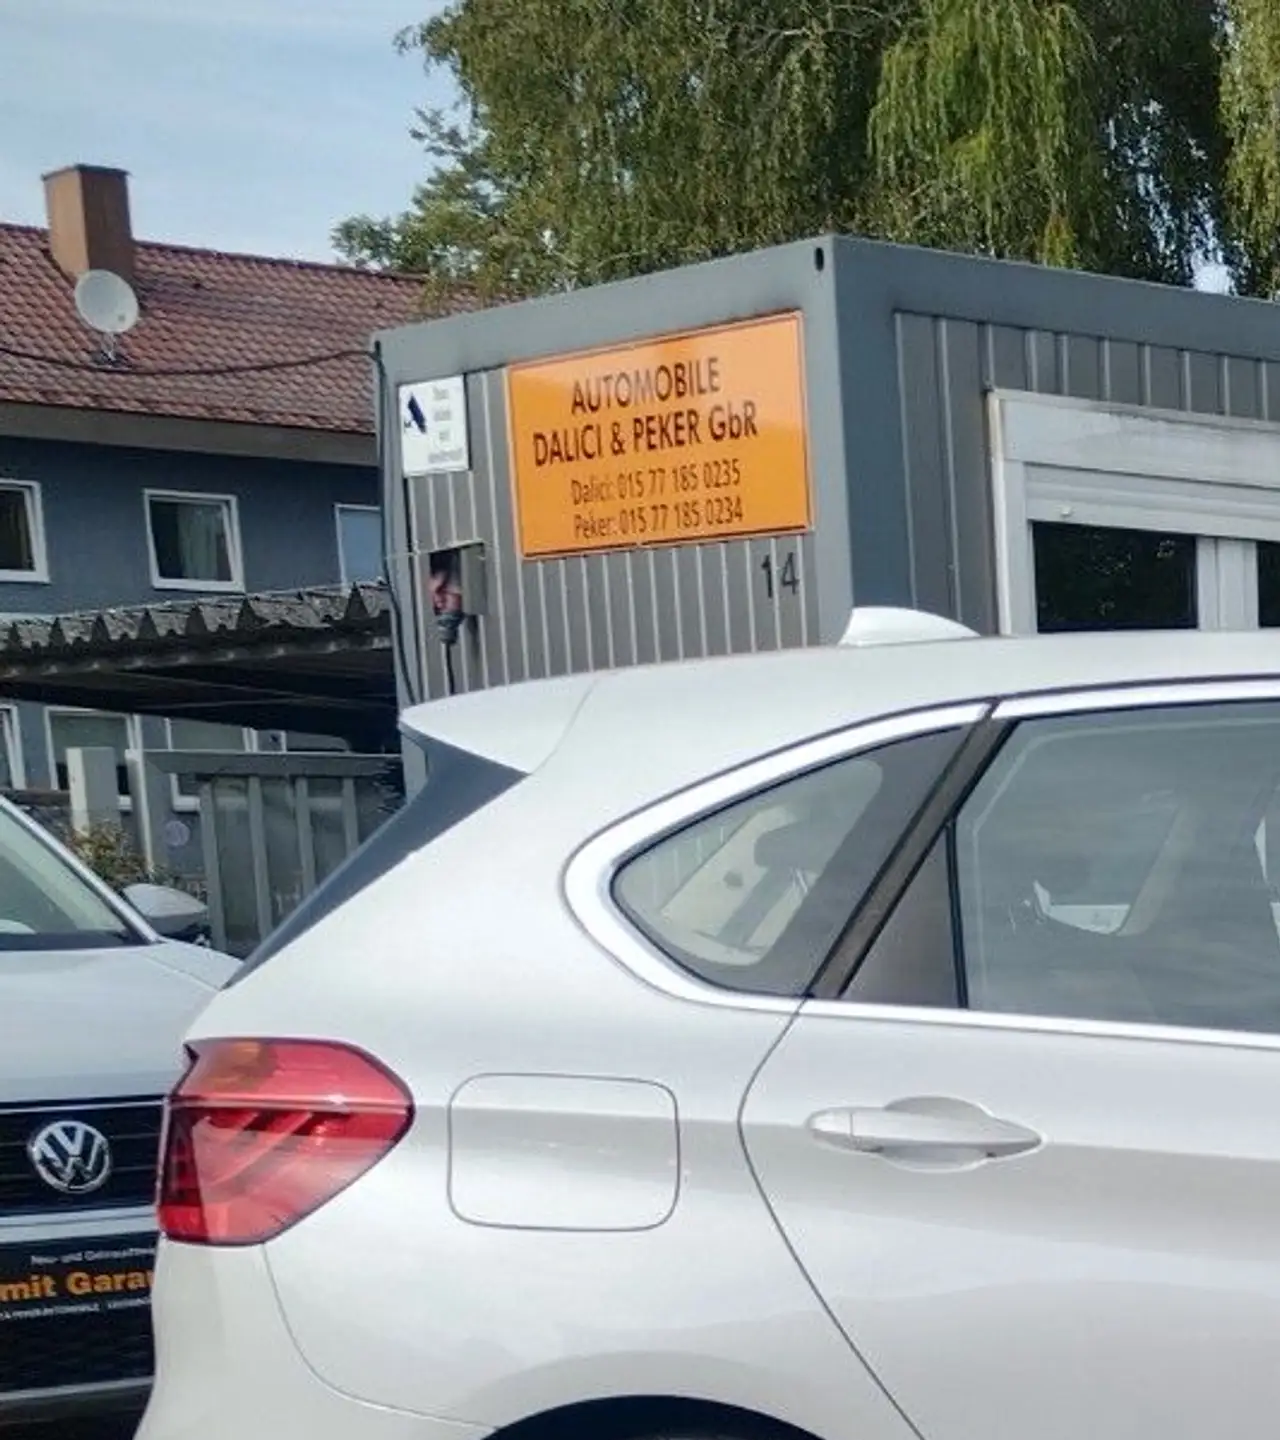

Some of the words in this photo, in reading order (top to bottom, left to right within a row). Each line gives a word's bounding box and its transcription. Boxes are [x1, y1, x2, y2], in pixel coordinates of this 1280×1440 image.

[571, 357, 721, 415] AUTOMOBILE
[533, 422, 604, 466] DALICI
[610, 421, 626, 456] &
[633, 408, 702, 453] PEKER
[708, 400, 758, 442] GbR
[617, 470, 645, 500] 015
[650, 467, 666, 496] 77
[703, 458, 741, 489] 0235
[620, 507, 647, 535] 015
[652, 504, 669, 532] 77
[674, 500, 701, 529] 185
[706, 495, 744, 526] 0234
[761, 551, 799, 598] 14
[0, 1274, 57, 1302] mit
